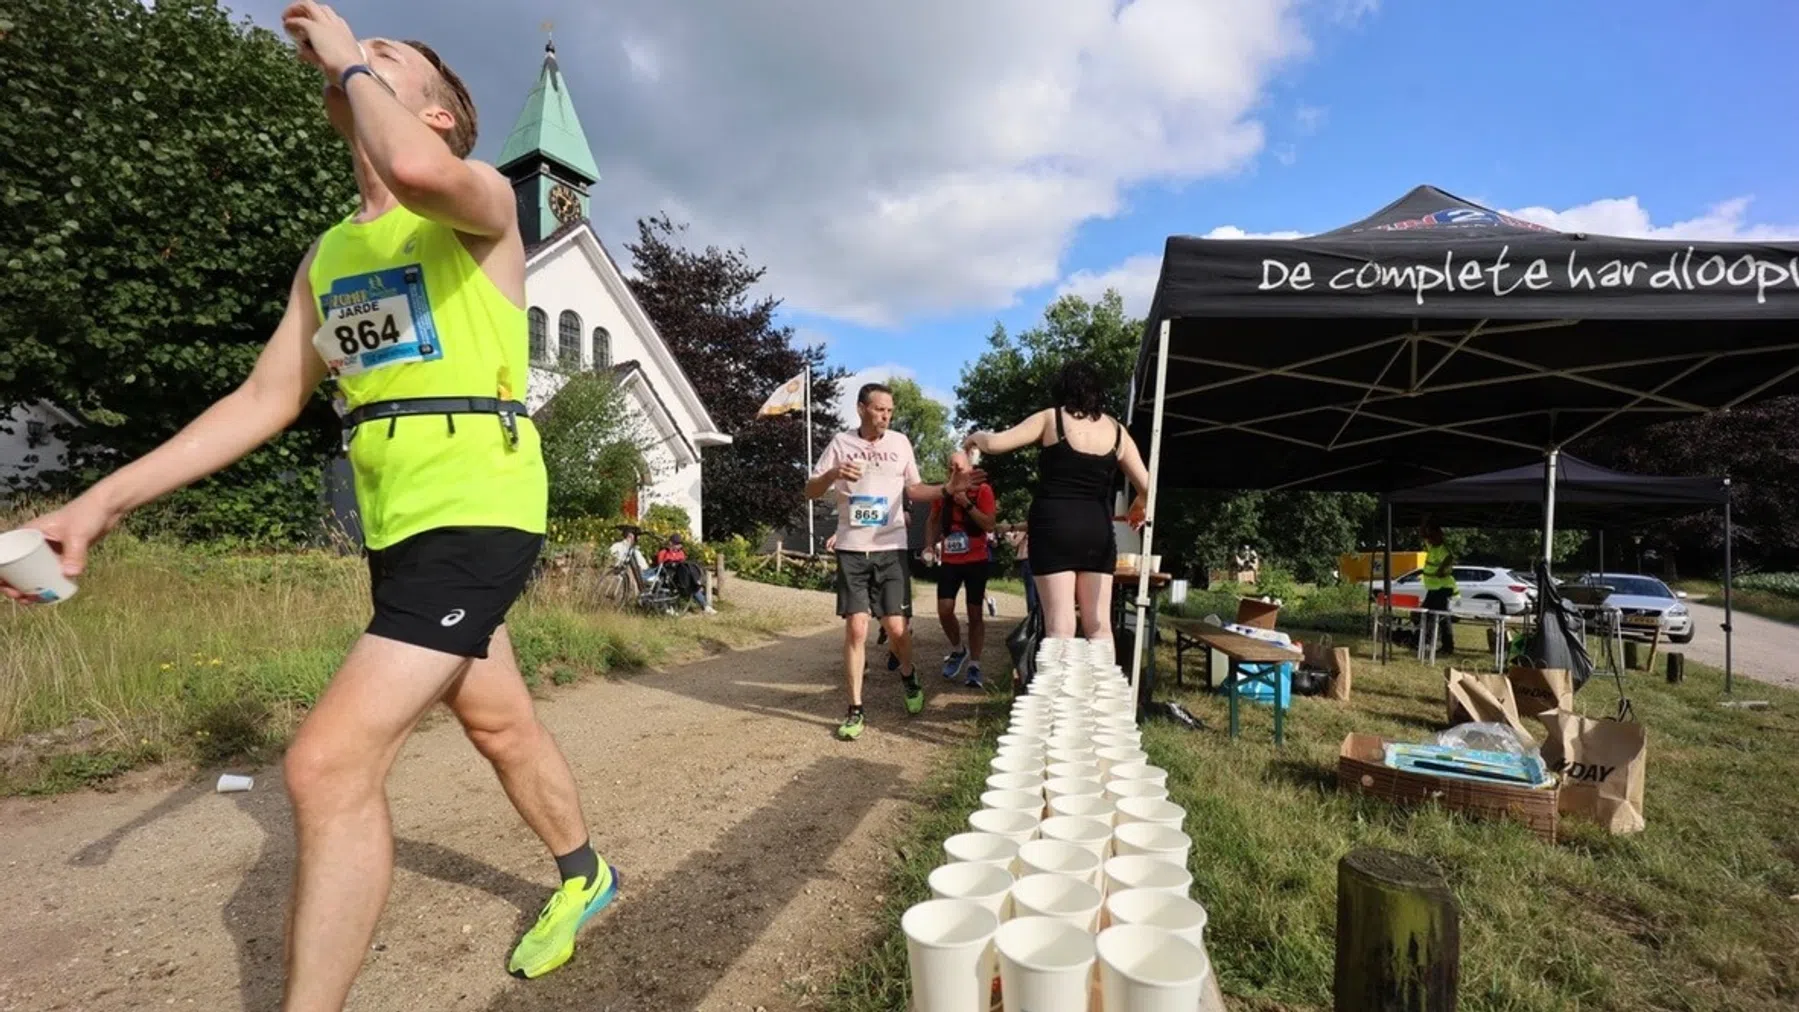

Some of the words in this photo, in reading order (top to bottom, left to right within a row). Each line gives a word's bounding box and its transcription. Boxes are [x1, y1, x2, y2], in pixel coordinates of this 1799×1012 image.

[1258, 259, 1315, 290] De
[1329, 245, 1552, 305] complete
[338, 301, 379, 319] JARDE
[335, 314, 400, 355] 864
[854, 509, 878, 520] 865
